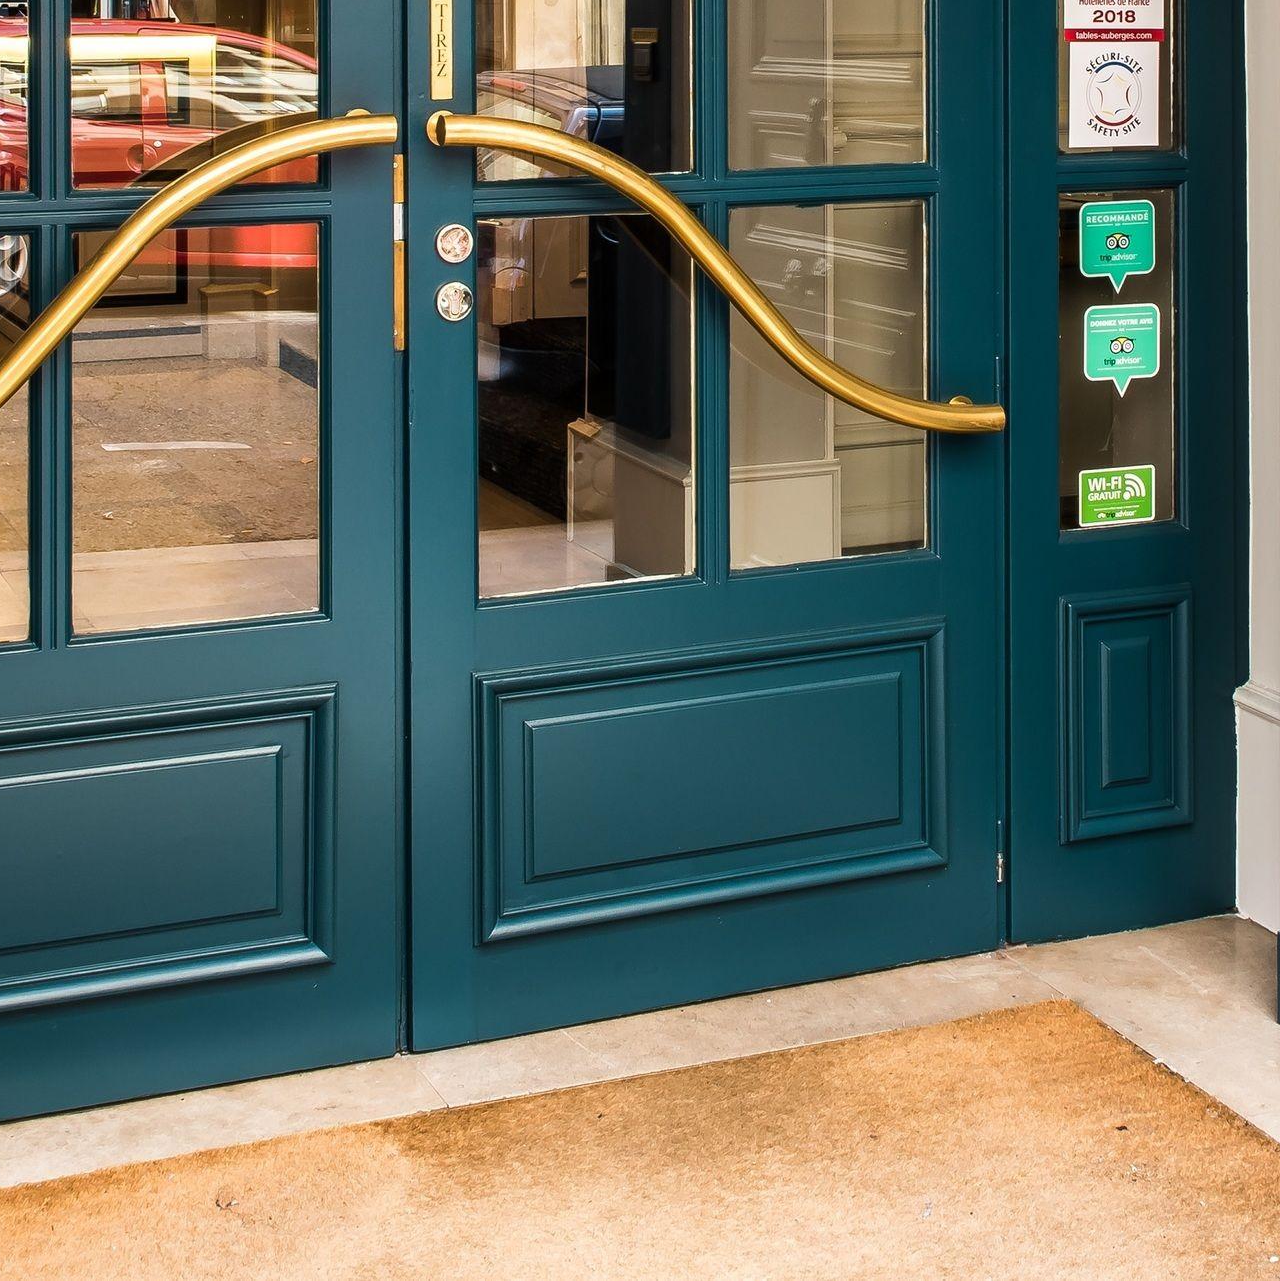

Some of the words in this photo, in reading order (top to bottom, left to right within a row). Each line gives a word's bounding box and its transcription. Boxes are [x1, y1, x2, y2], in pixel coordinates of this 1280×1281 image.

[1093, 10, 1136, 23] 2018
[435, 3, 448, 77] TIREZ
[1075, 31, 1153, 41] tables-auberges.com
[1086, 118, 1120, 137] SAFETY
[1122, 118, 1142, 135] SITE
[1086, 212, 1149, 224] RECOMMANDÉ
[1099, 253, 1137, 262] tripadvisor
[1104, 357, 1141, 366] tripadvisor
[1088, 476, 1122, 491] WI-FI
[1088, 490, 1122, 502] GRATUIT
[1106, 510, 1136, 518] tripadvisor
